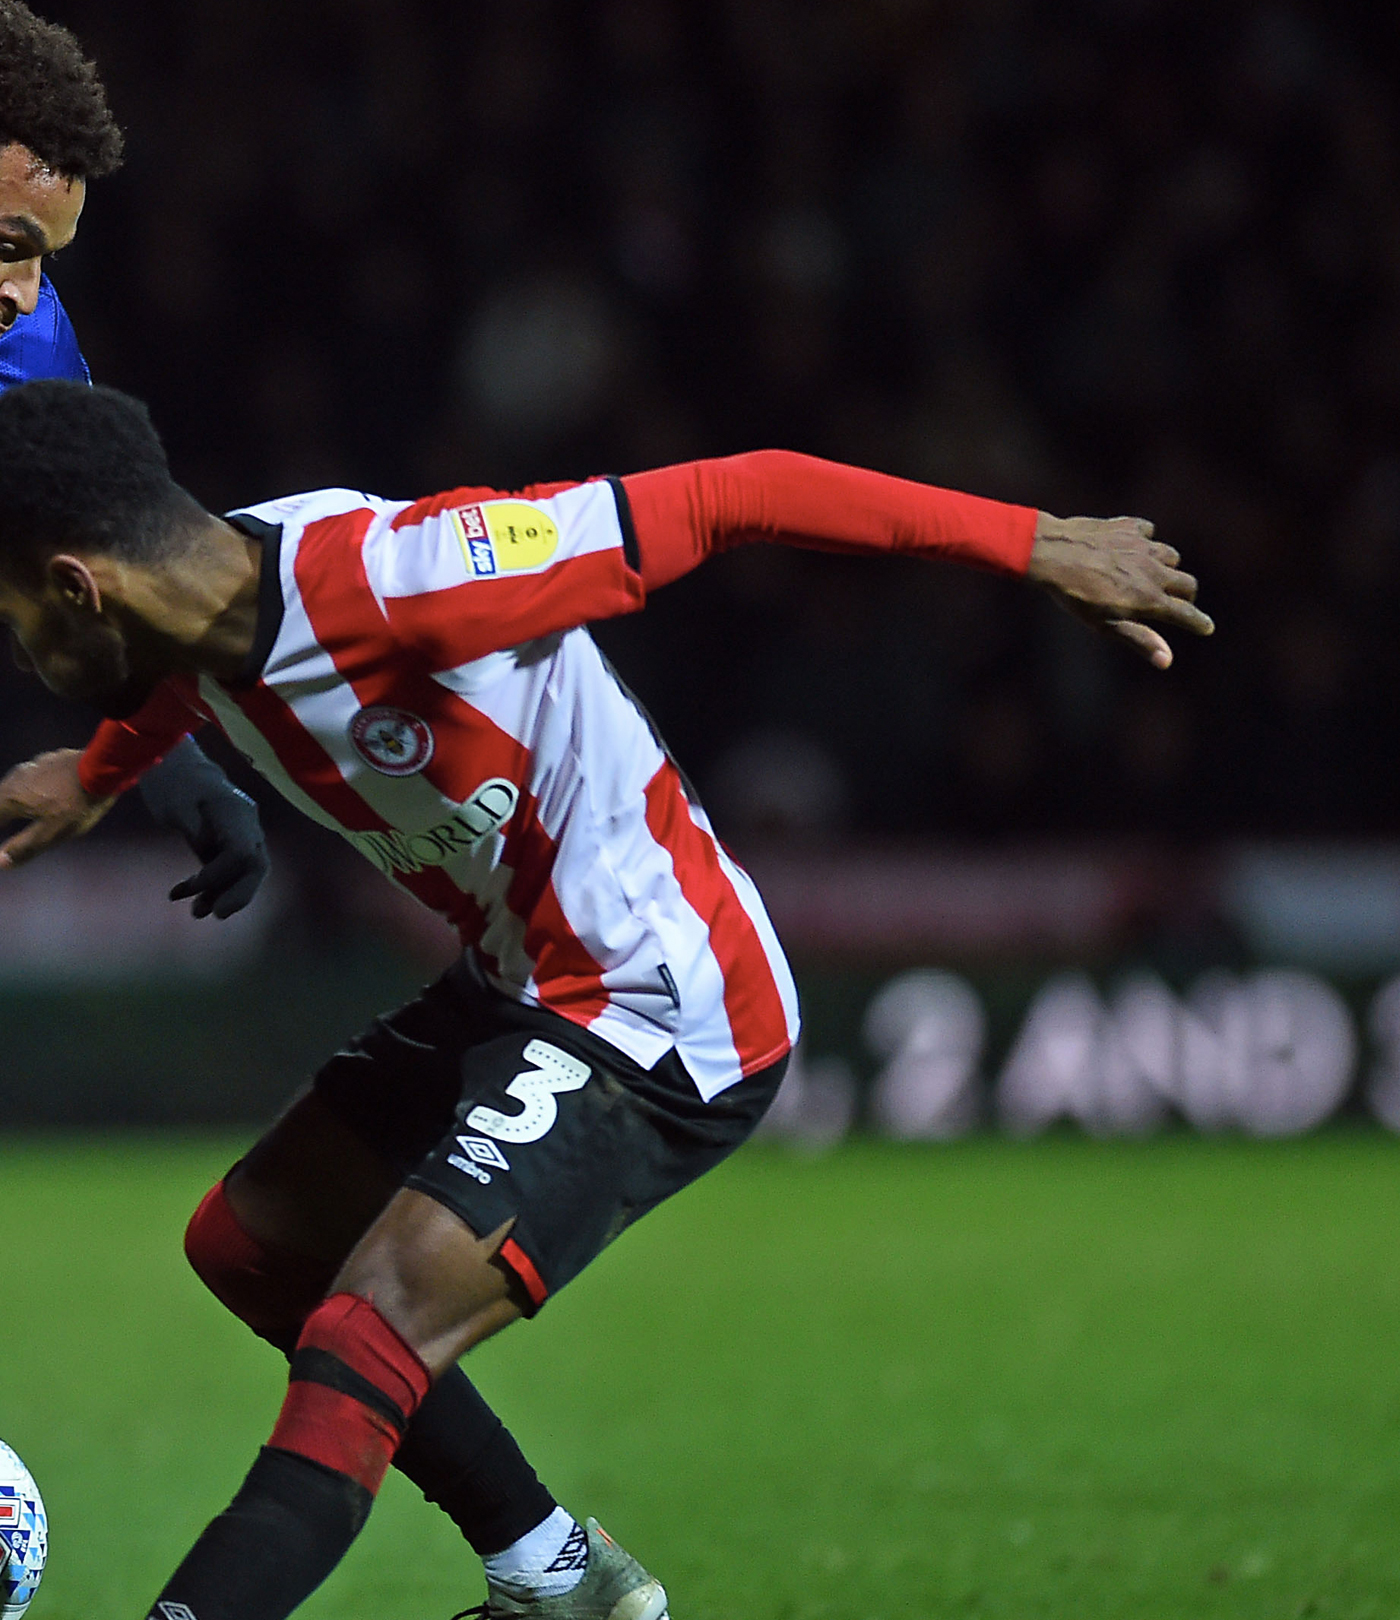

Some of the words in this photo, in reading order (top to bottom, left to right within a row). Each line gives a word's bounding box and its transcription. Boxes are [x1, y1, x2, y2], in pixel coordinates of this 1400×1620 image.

[461, 508, 485, 539] bet
[470, 540, 494, 573] sky
[862, 967, 987, 1142] 2
[997, 968, 1357, 1140] AND
[466, 1038, 592, 1144] 3
